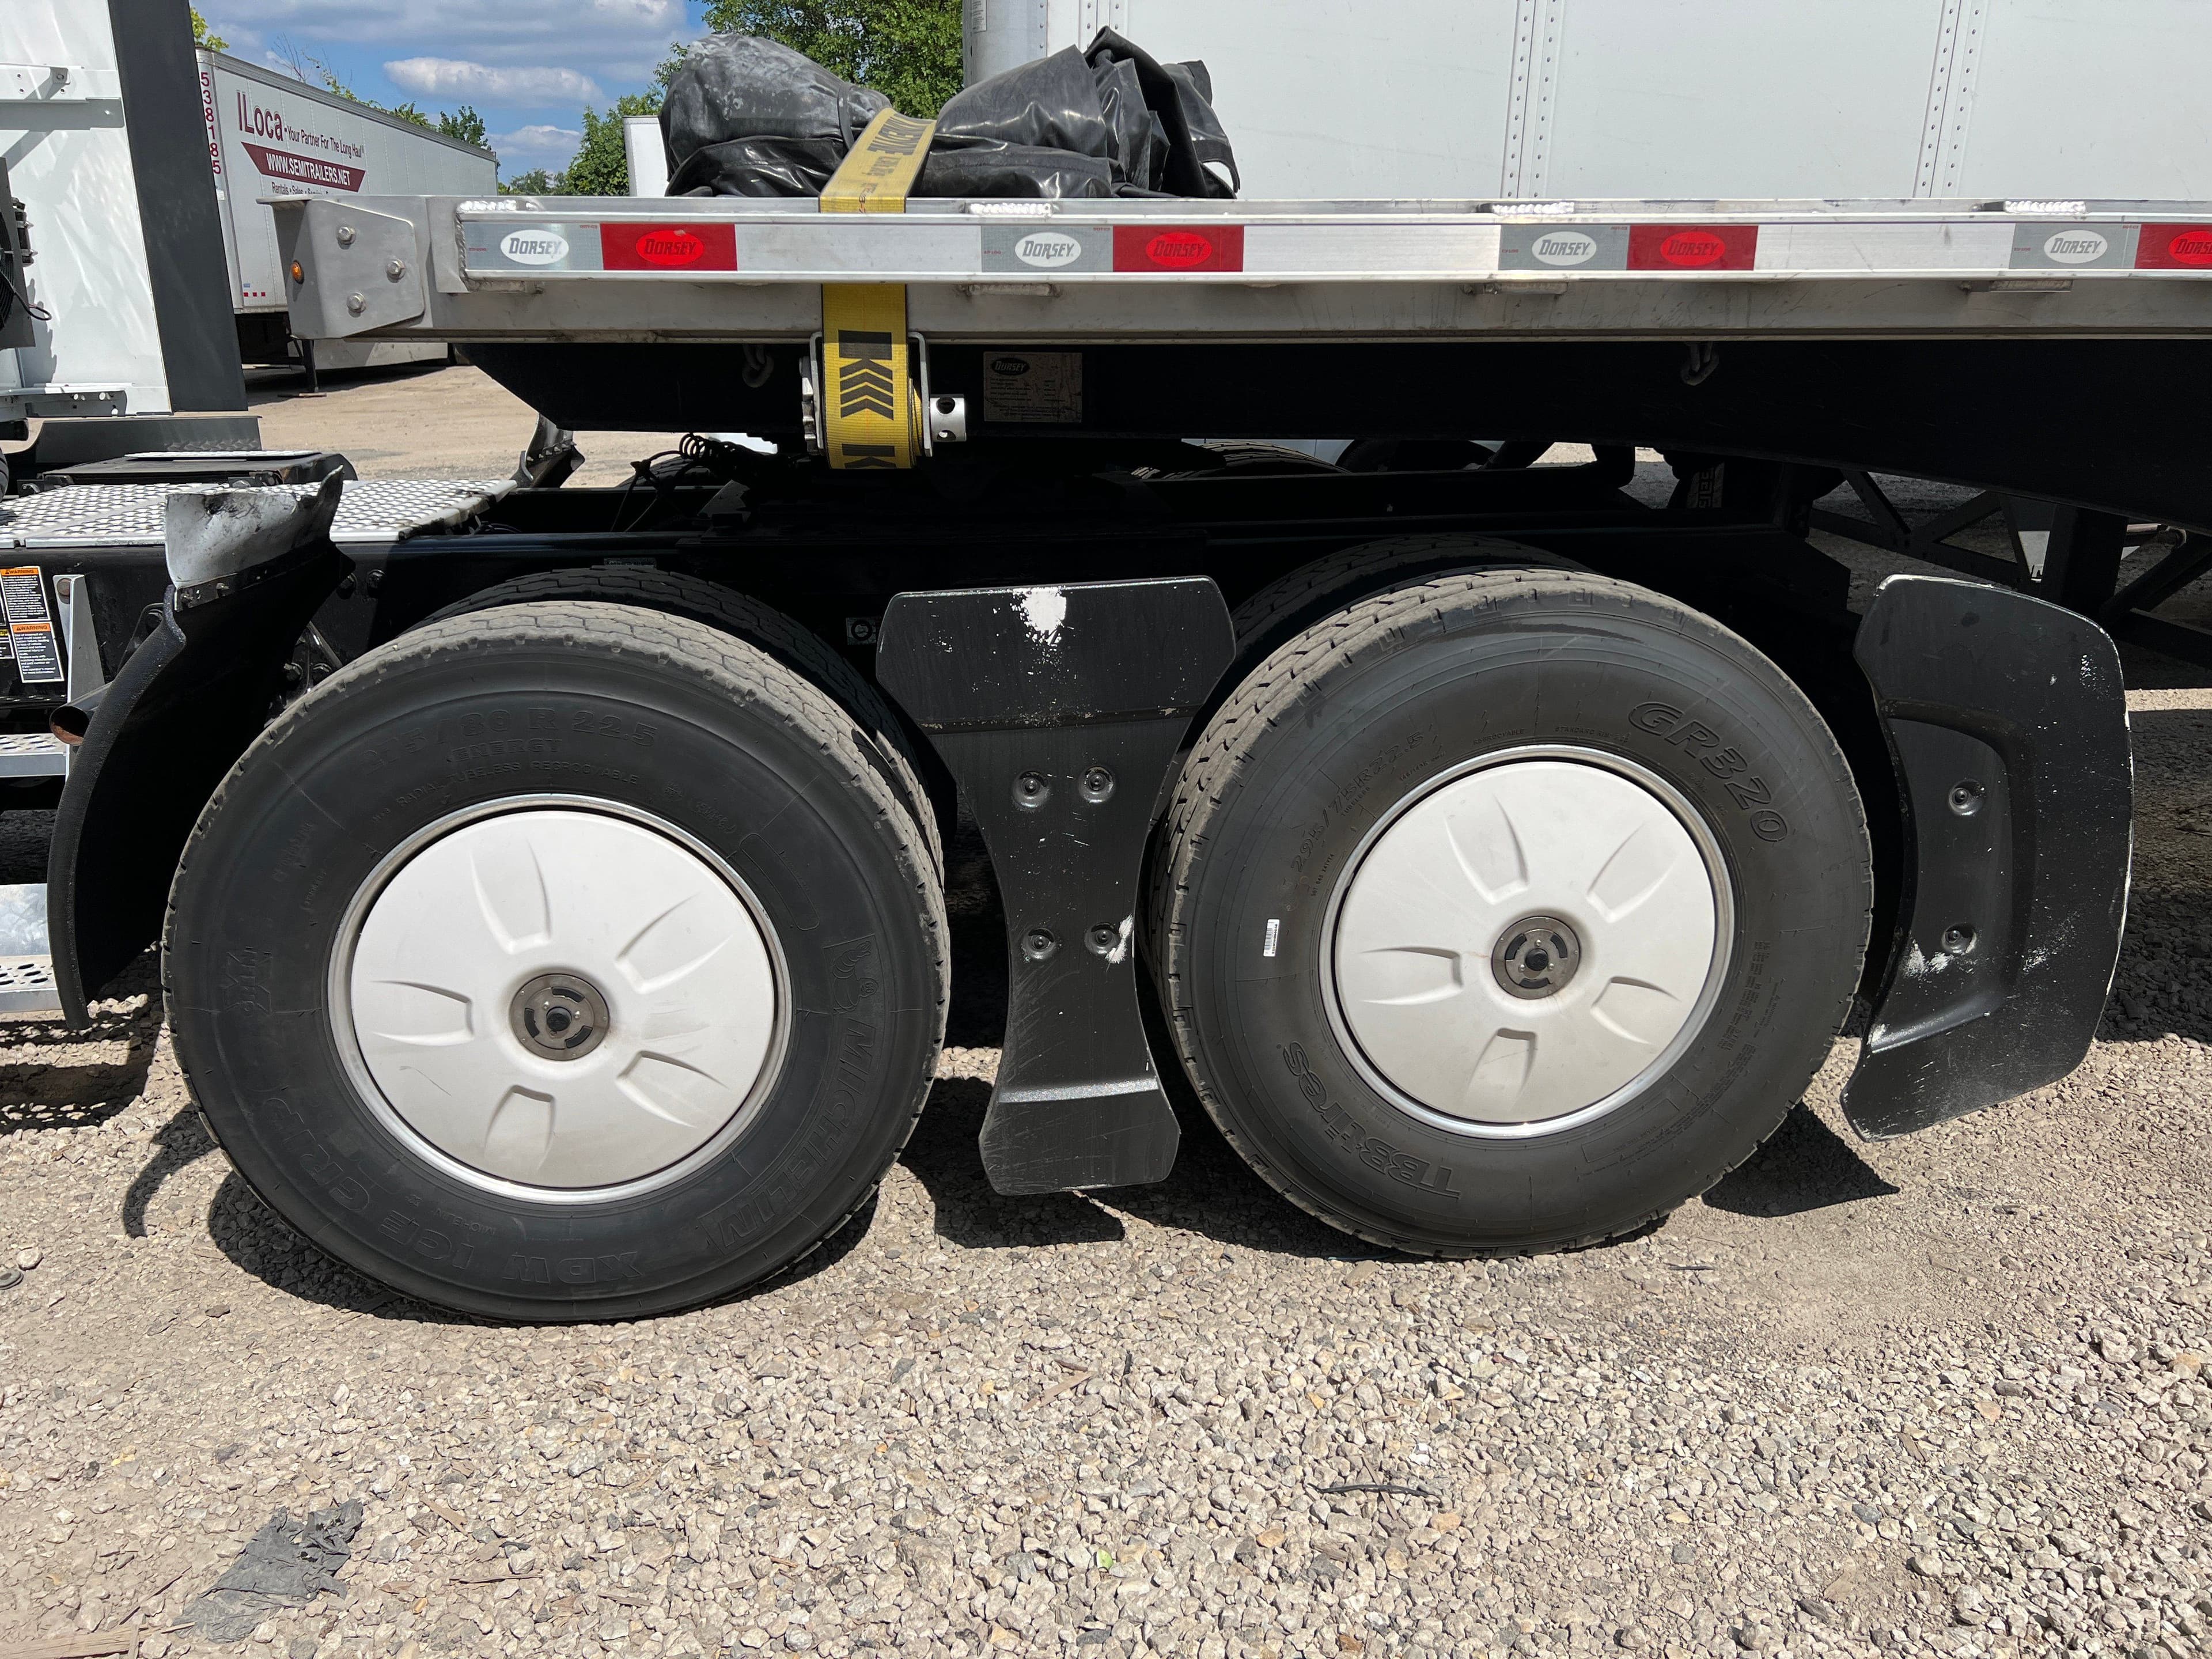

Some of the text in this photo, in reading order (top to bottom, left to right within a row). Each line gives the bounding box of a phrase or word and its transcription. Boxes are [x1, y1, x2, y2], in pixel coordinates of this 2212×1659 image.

[301, 130, 320, 148] Partner
[321, 134, 329, 150] For
[330, 137, 340, 152] The
[340, 139, 351, 159] Long
[266, 152, 350, 187] WWW.SEMITRAILERS.NET
[509, 237, 560, 255] DORSEY
[644, 238, 696, 256] DORSEY
[1022, 240, 1074, 258] DORSEY
[1154, 240, 1205, 258] DORSEY
[1538, 239, 1589, 256] DORSEY
[1667, 239, 1718, 256] DORSEY
[2050, 237, 2102, 255] DORSEY
[571, 710, 658, 747] 22.5
[449, 738, 563, 763] ENERGY
[446, 762, 521, 784] TUBELESS
[530, 760, 640, 785] REGROOVABLE
[1628, 700, 1789, 842] GR320
[720, 1017, 877, 1249] MICHELIN
